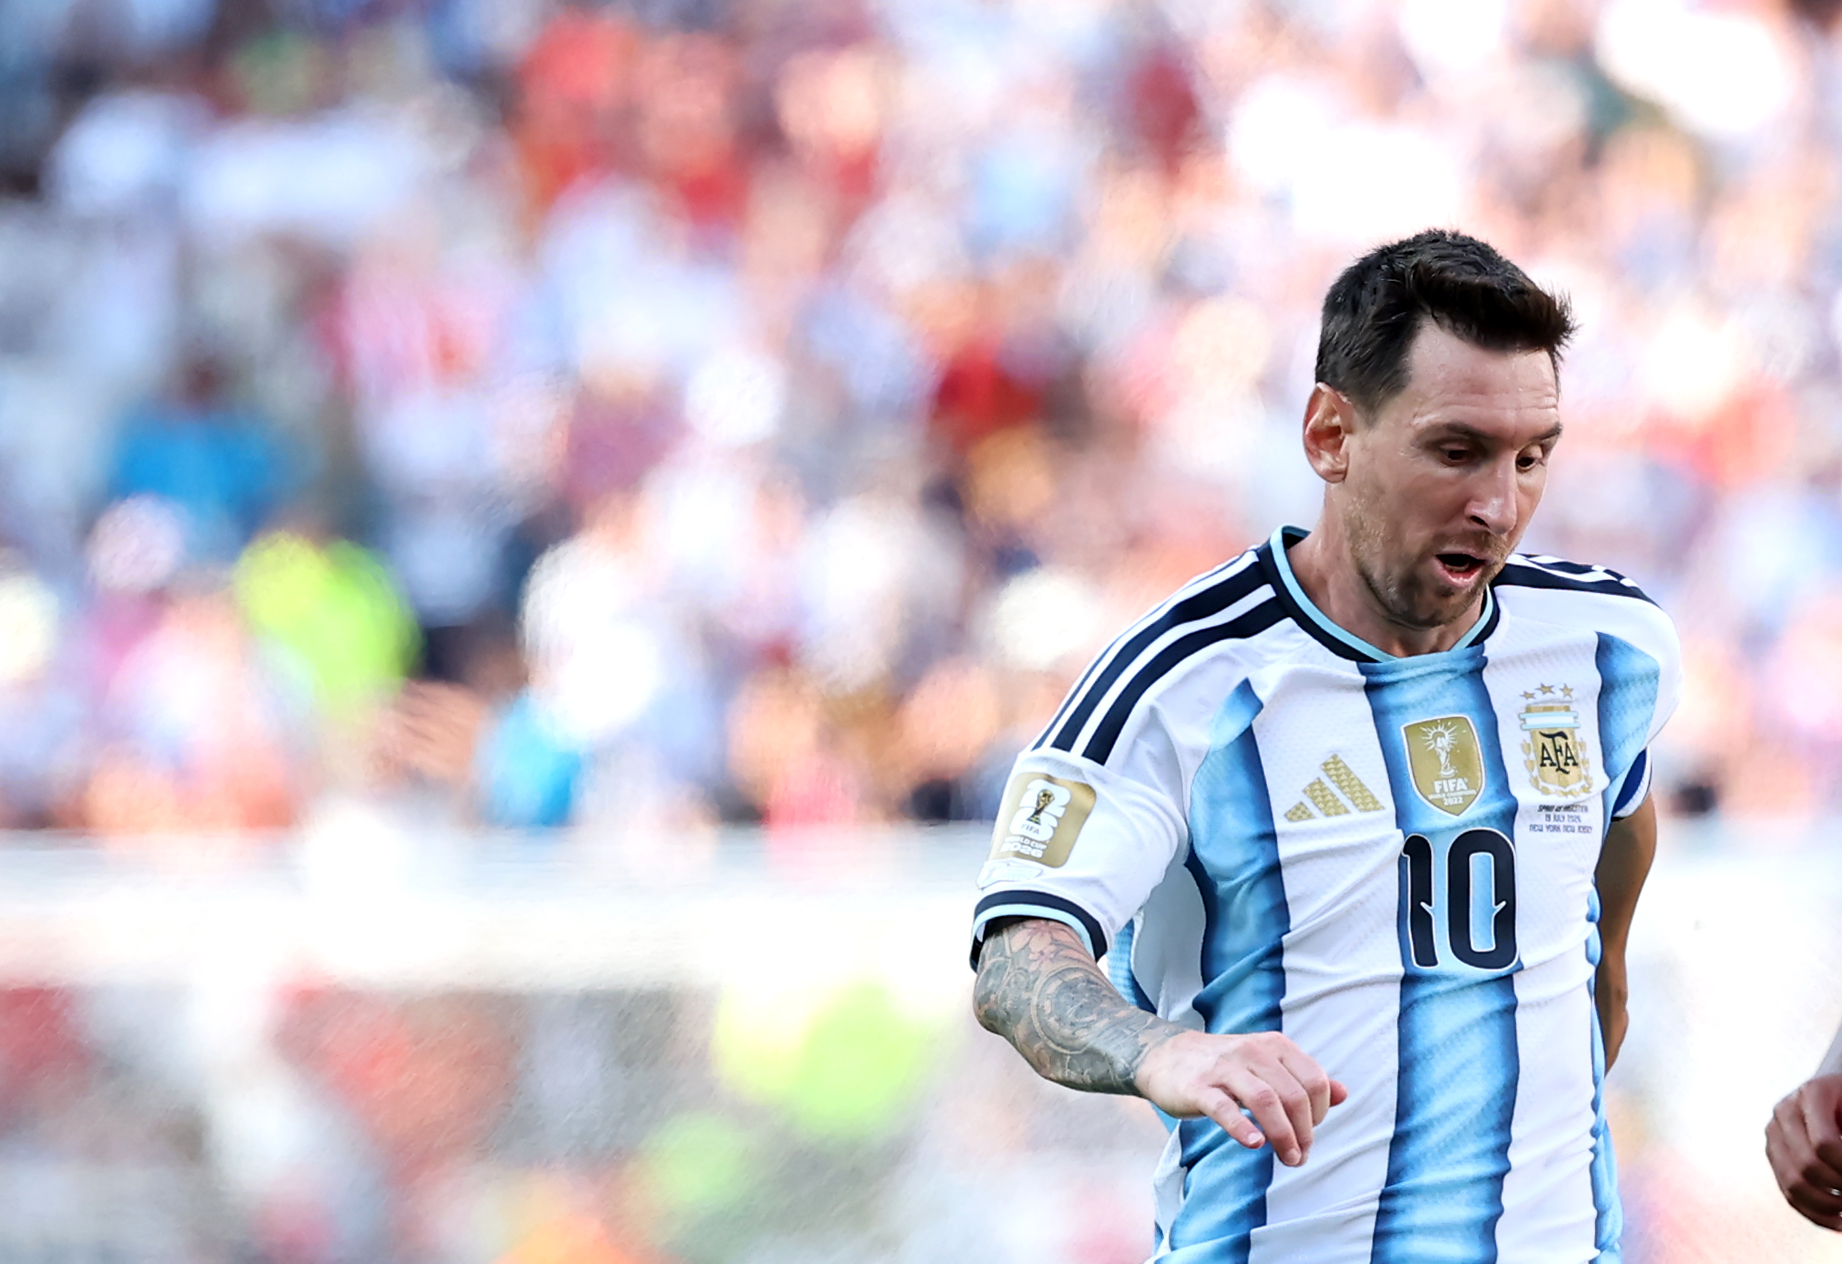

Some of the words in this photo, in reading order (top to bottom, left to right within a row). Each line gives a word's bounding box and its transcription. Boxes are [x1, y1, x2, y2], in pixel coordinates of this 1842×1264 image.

[1539, 731, 1579, 775] AFA
[1433, 778, 1468, 794] FIFA
[1401, 827, 1519, 971] 10
